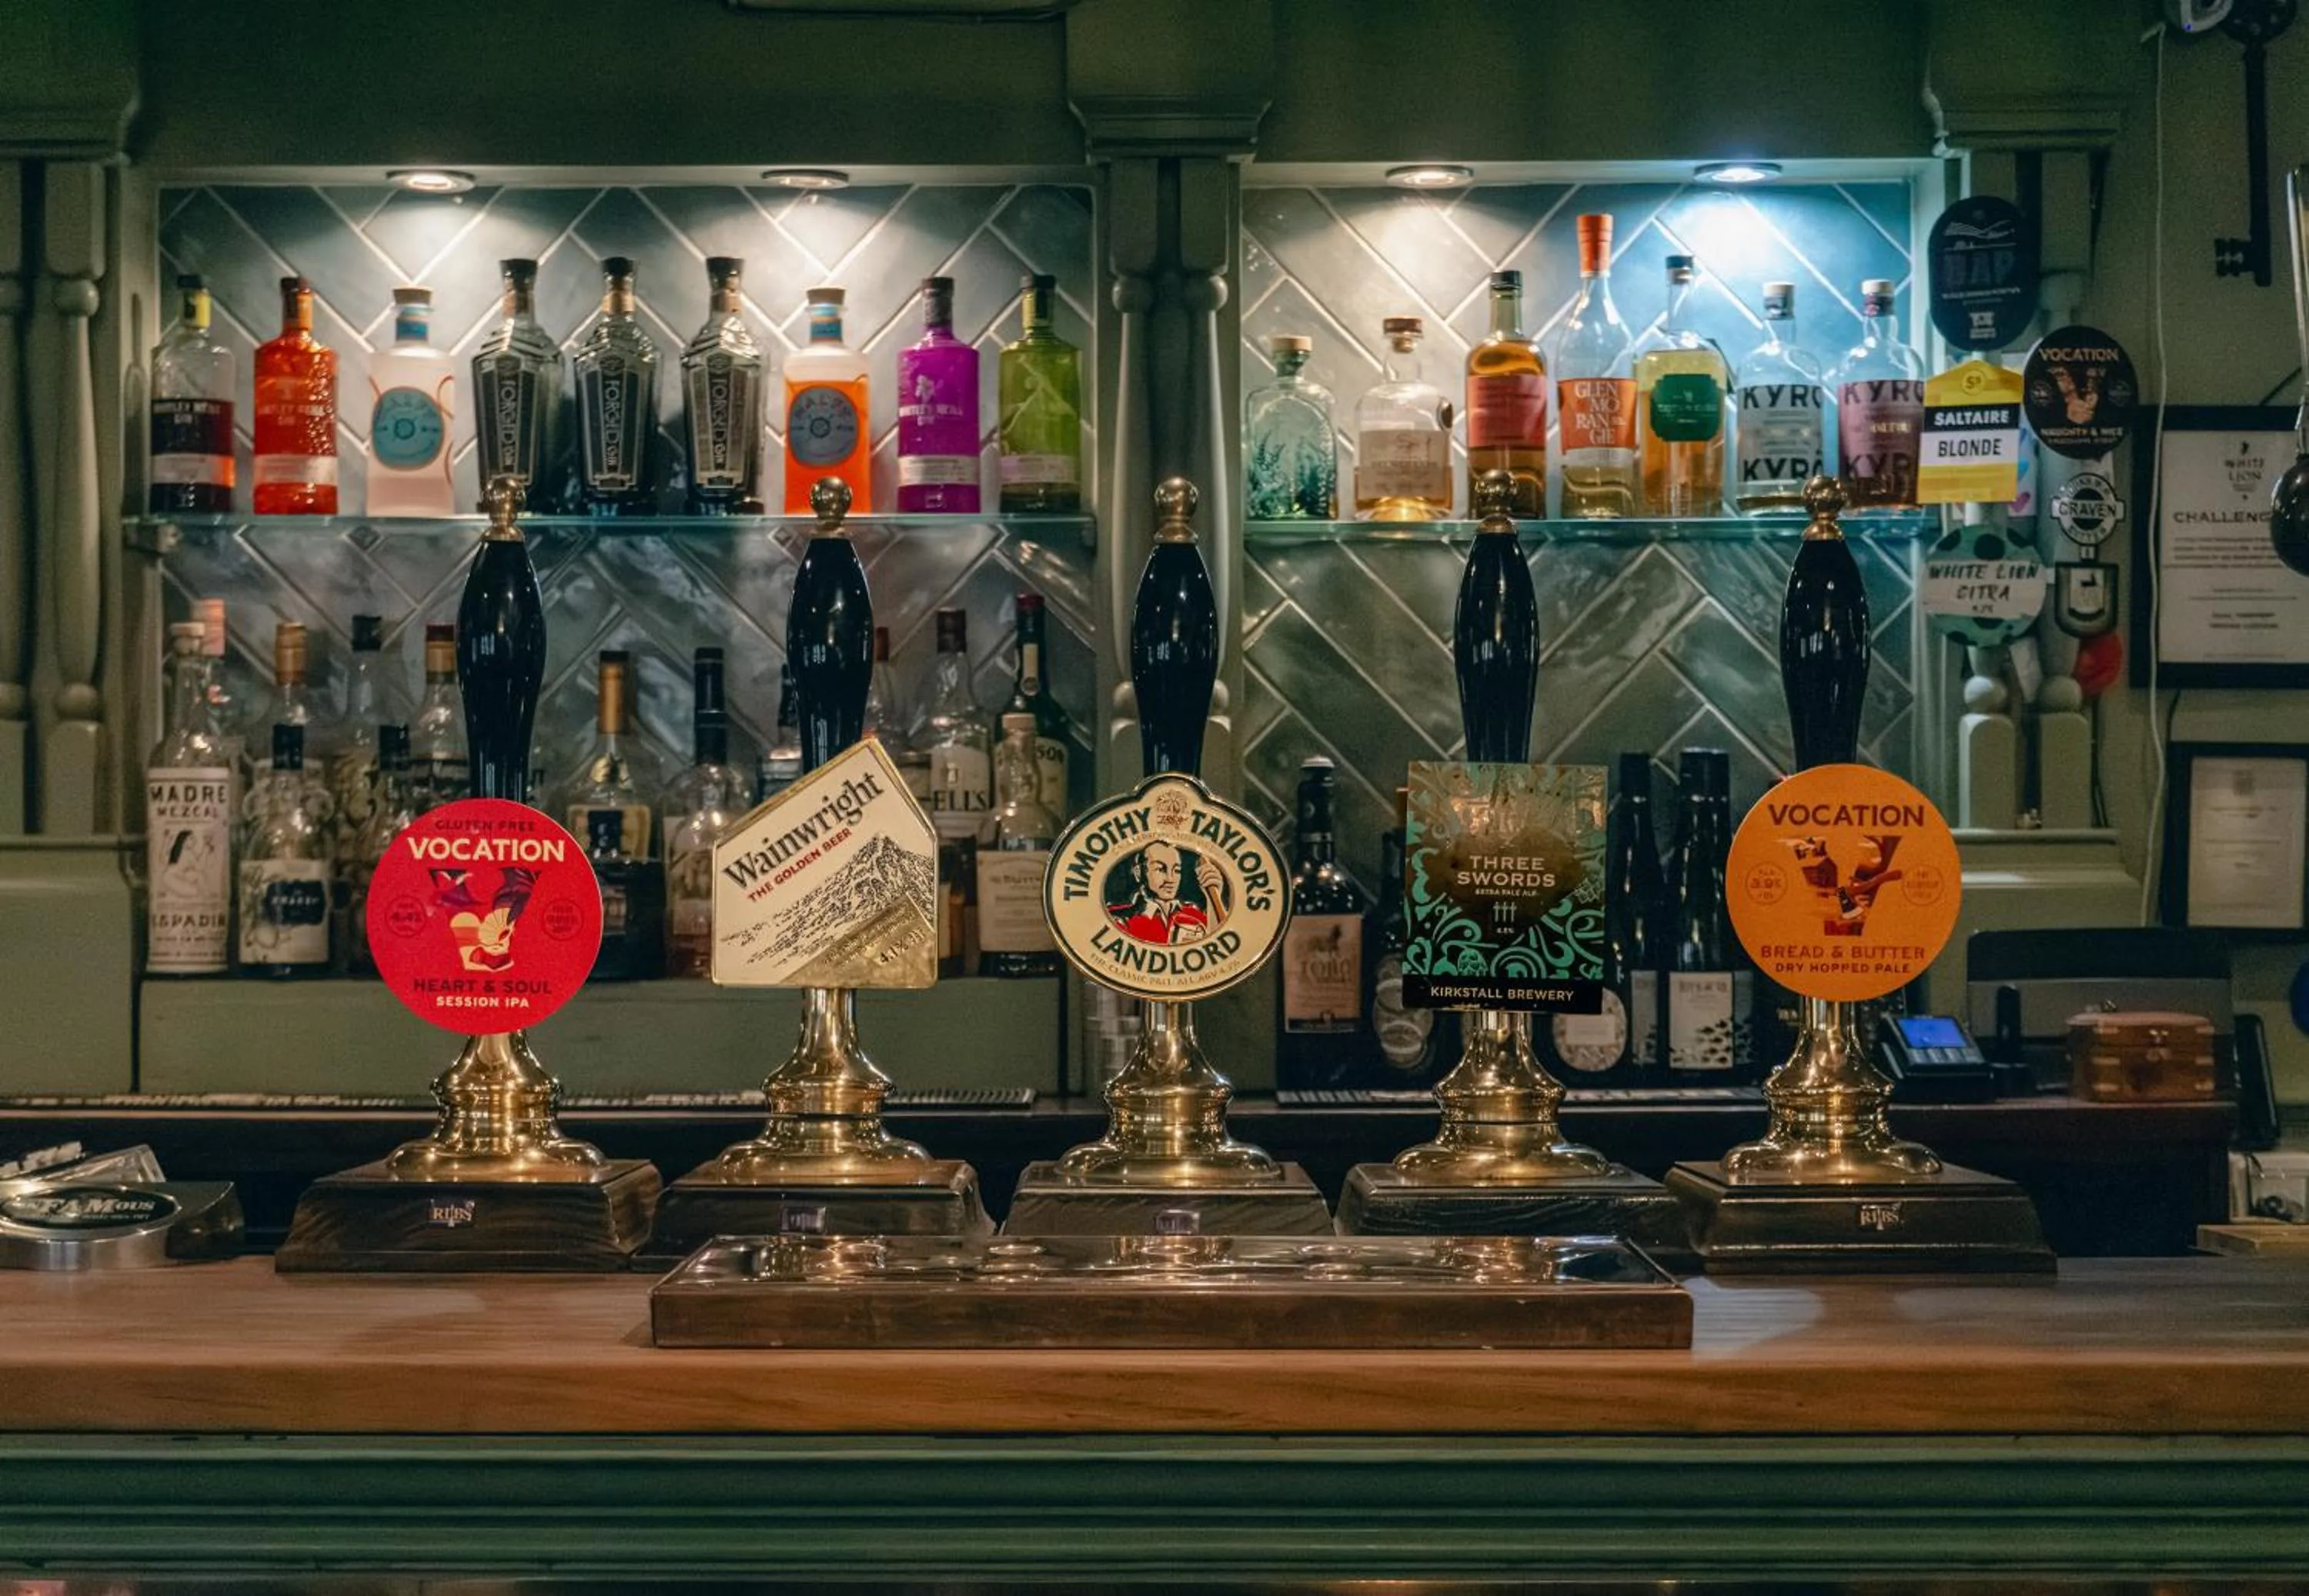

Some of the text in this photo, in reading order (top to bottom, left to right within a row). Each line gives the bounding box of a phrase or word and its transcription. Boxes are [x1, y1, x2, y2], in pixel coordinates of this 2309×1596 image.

[2039, 348, 2120, 362] VOCATION
[1575, 381, 1619, 398] GLEN
[1934, 409, 2010, 426] SALTAIRE
[1938, 438, 2002, 457] BLONDE
[2058, 501, 2116, 517] CRAVEN
[2173, 511, 2273, 524] CHALLENG
[1928, 563, 2039, 579] WHITE LION
[1956, 585, 2011, 601] CITRA
[150, 785, 226, 804] MADRE
[933, 790, 987, 810] ELL'S
[156, 807, 219, 818] MEZCAL
[1767, 804, 1925, 827] VOCATION
[434, 820, 536, 833] GLUTEN FREE
[721, 772, 885, 890] Wainwright
[406, 836, 565, 863] VOCATION
[747, 827, 853, 903] THE GOLDEN BEER
[1062, 807, 1152, 902] TIMOTHY
[1191, 809, 1272, 913] TAYLOR'S
[1469, 855, 1545, 871] THREE
[1456, 872, 1556, 887] SWORDS
[1090, 924, 1241, 976] LANDLORD
[1760, 945, 1925, 960] BREAD & BUTTER
[1775, 963, 1911, 973] DRY HOPPED PALE
[413, 978, 553, 994] HEART & SOUL
[1430, 986, 1574, 1001] KIRKSTALL BREWERY
[436, 996, 530, 1008] SESSION IPA
